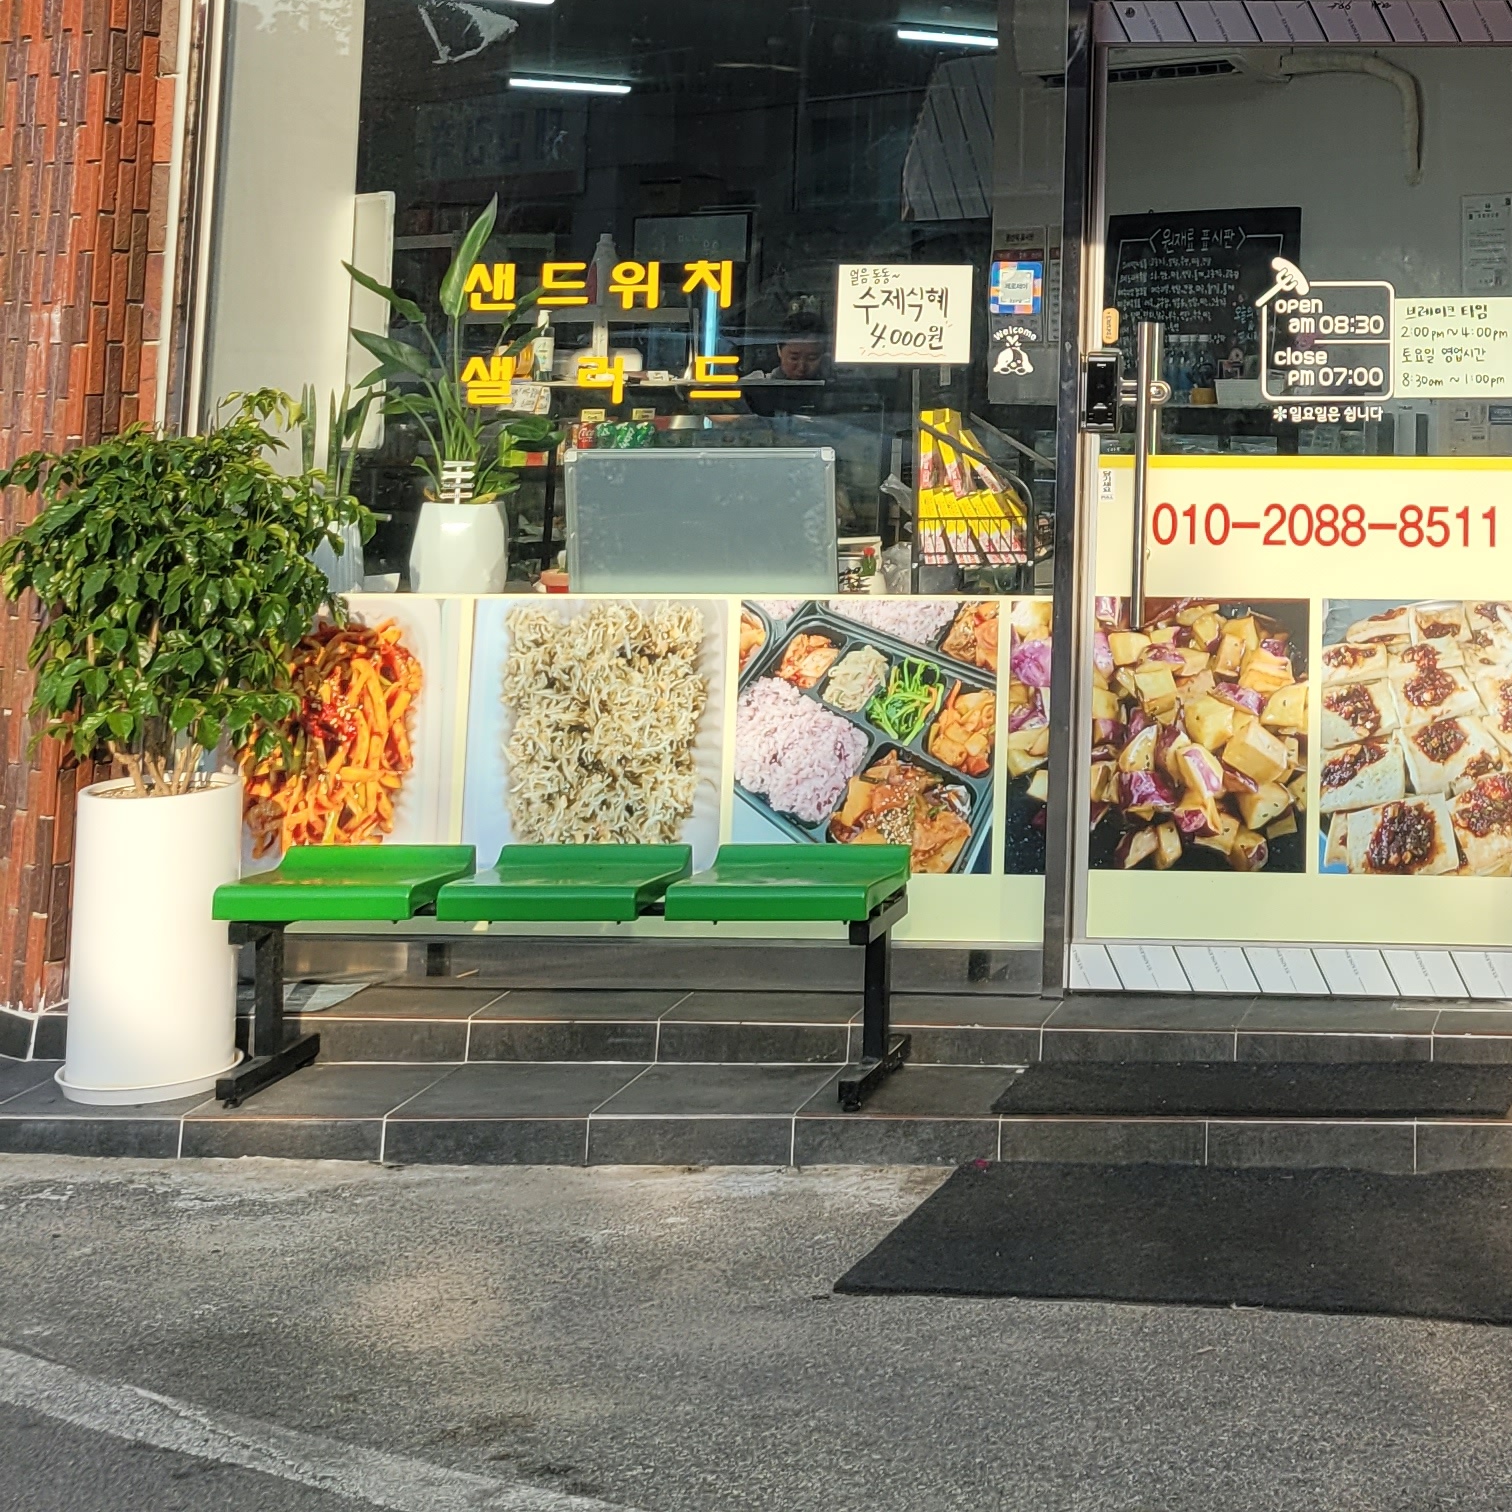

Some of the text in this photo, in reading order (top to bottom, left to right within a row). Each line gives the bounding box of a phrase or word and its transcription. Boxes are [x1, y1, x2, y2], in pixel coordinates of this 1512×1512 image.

[1162, 228, 1236, 253] 원재료 표시판
[463, 259, 735, 312] 샌드위치
[850, 268, 870, 287] 얼음
[853, 286, 949, 326] 수제식혜
[1274, 299, 1323, 314] open
[1405, 305, 1488, 320] 브레이크 타임
[993, 325, 1037, 341] Welcome
[1288, 315, 1386, 335] am 08:30
[1274, 346, 1328, 366] close
[1401, 346, 1487, 364] 토요일 영업시간
[460, 355, 742, 406] 샐러드
[1287, 367, 1384, 386] pm 07:00
[1402, 372, 1444, 388] 8:30am
[1464, 374, 1506, 388] 1:00pm
[1152, 503, 1497, 548] 010-2088-8511
